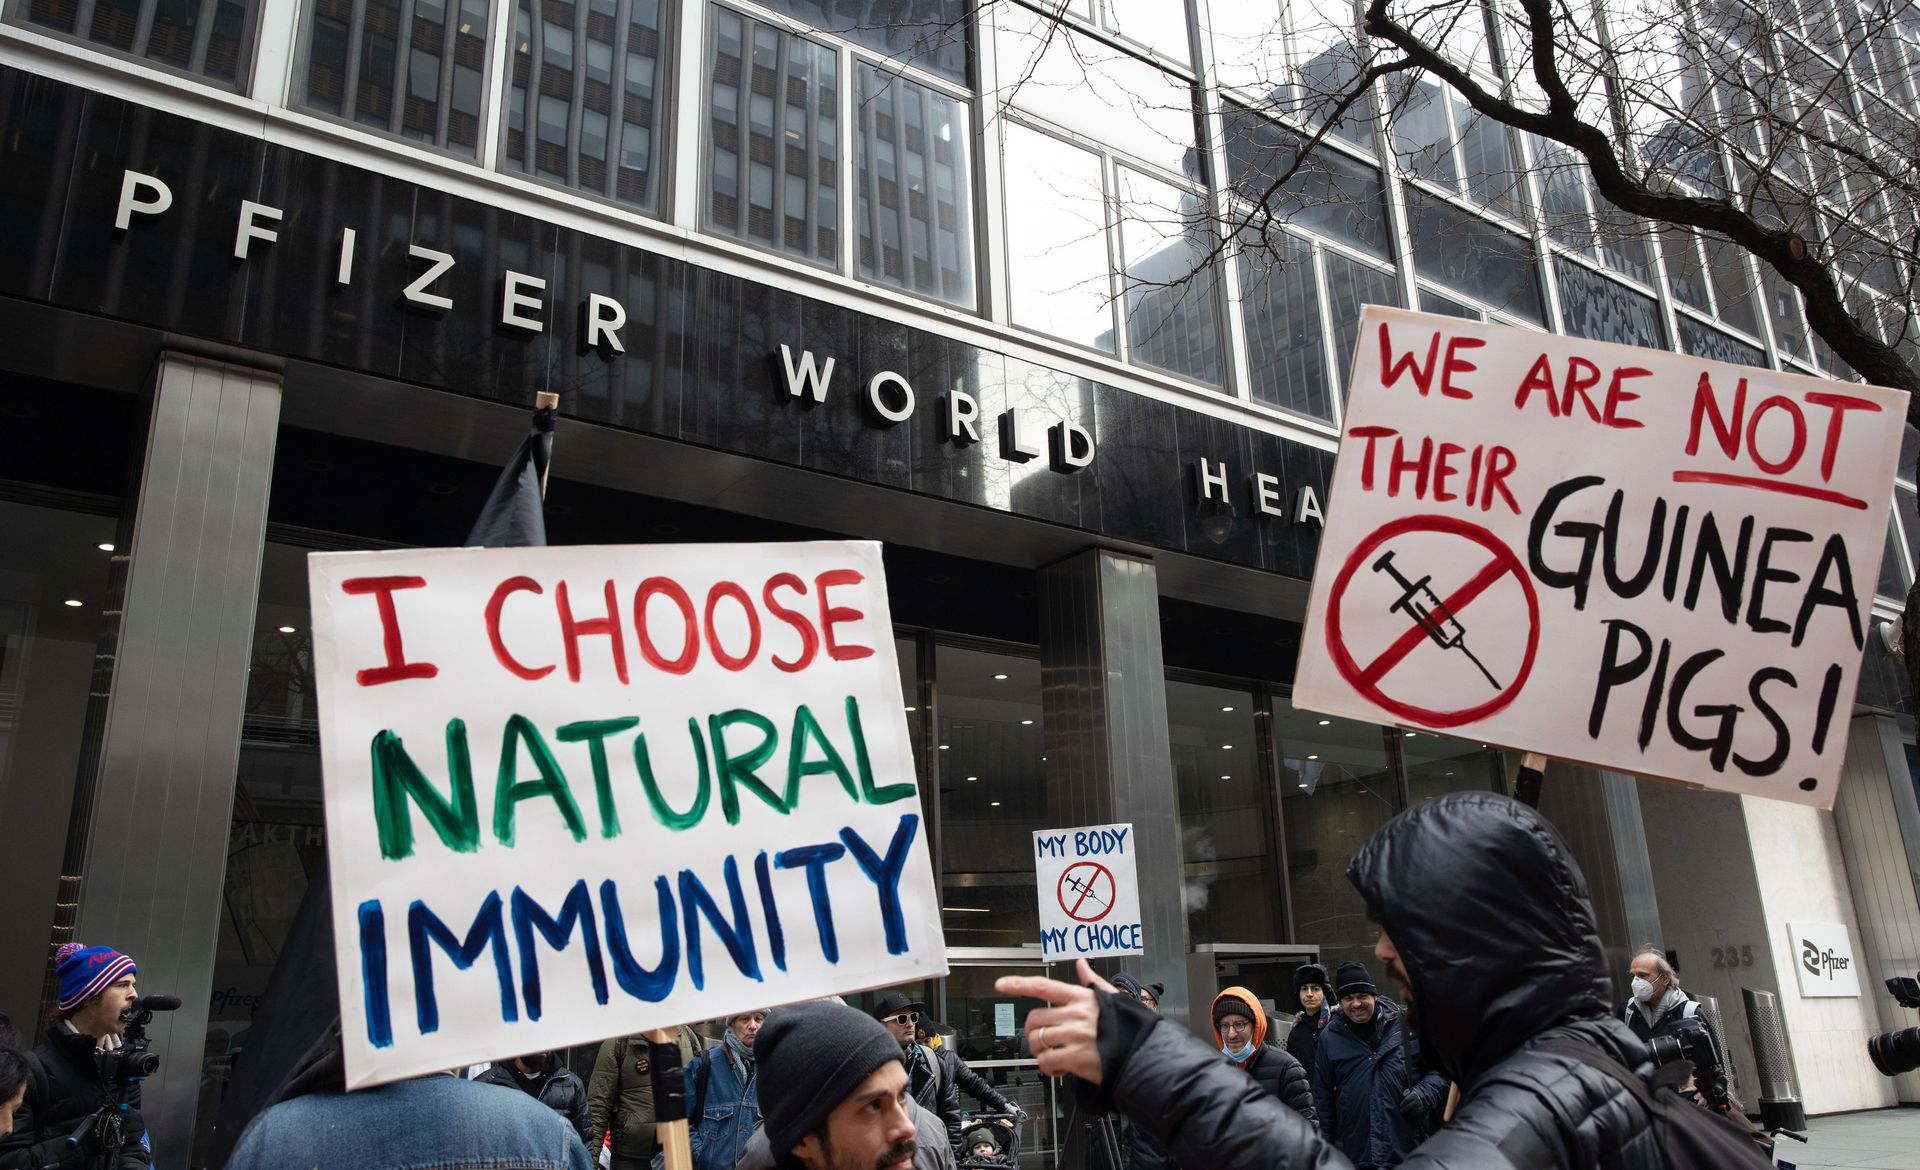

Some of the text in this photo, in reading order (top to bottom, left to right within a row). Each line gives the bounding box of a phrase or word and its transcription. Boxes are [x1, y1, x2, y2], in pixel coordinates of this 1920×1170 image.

[115, 170, 626, 353] PFIZER
[779, 344, 1095, 469] WORLD
[1379, 323, 1883, 484] WE ARE NOT
[1348, 426, 1864, 651] THEIR GUINEA
[341, 569, 875, 687] I CHOOSE
[1588, 619, 1844, 791] PIGS!
[371, 695, 917, 862] NATURAL
[1037, 827, 1128, 858] MY BODY
[357, 813, 919, 1049] IMMUNITY
[1040, 924, 1142, 954] MY CHOICE
[1711, 945, 1754, 968] 235
[1821, 947, 1850, 981] Pfizer
